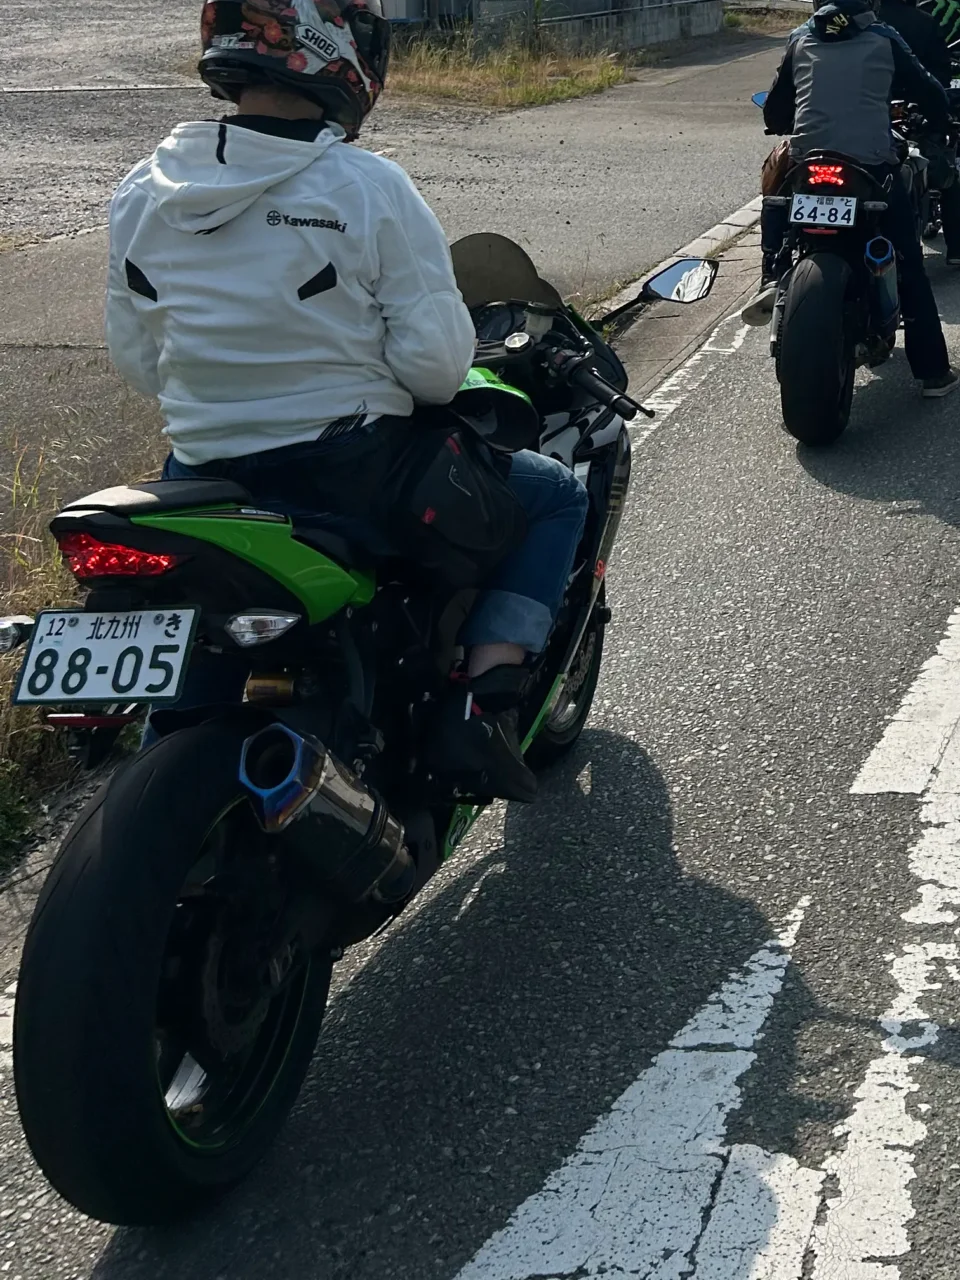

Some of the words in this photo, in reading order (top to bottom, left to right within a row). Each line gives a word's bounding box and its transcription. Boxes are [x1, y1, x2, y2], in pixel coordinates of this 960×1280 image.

[301, 28, 336, 58] SHOEI
[816, 196, 835, 206] 福岡
[844, 198, 853, 207] と
[282, 214, 348, 234] Kawasaki
[793, 205, 852, 224] 64-84
[46, 617, 67, 637] 12
[85, 615, 143, 640] 北九州
[164, 613, 182, 639] き
[27, 644, 181, 696] 88-05
